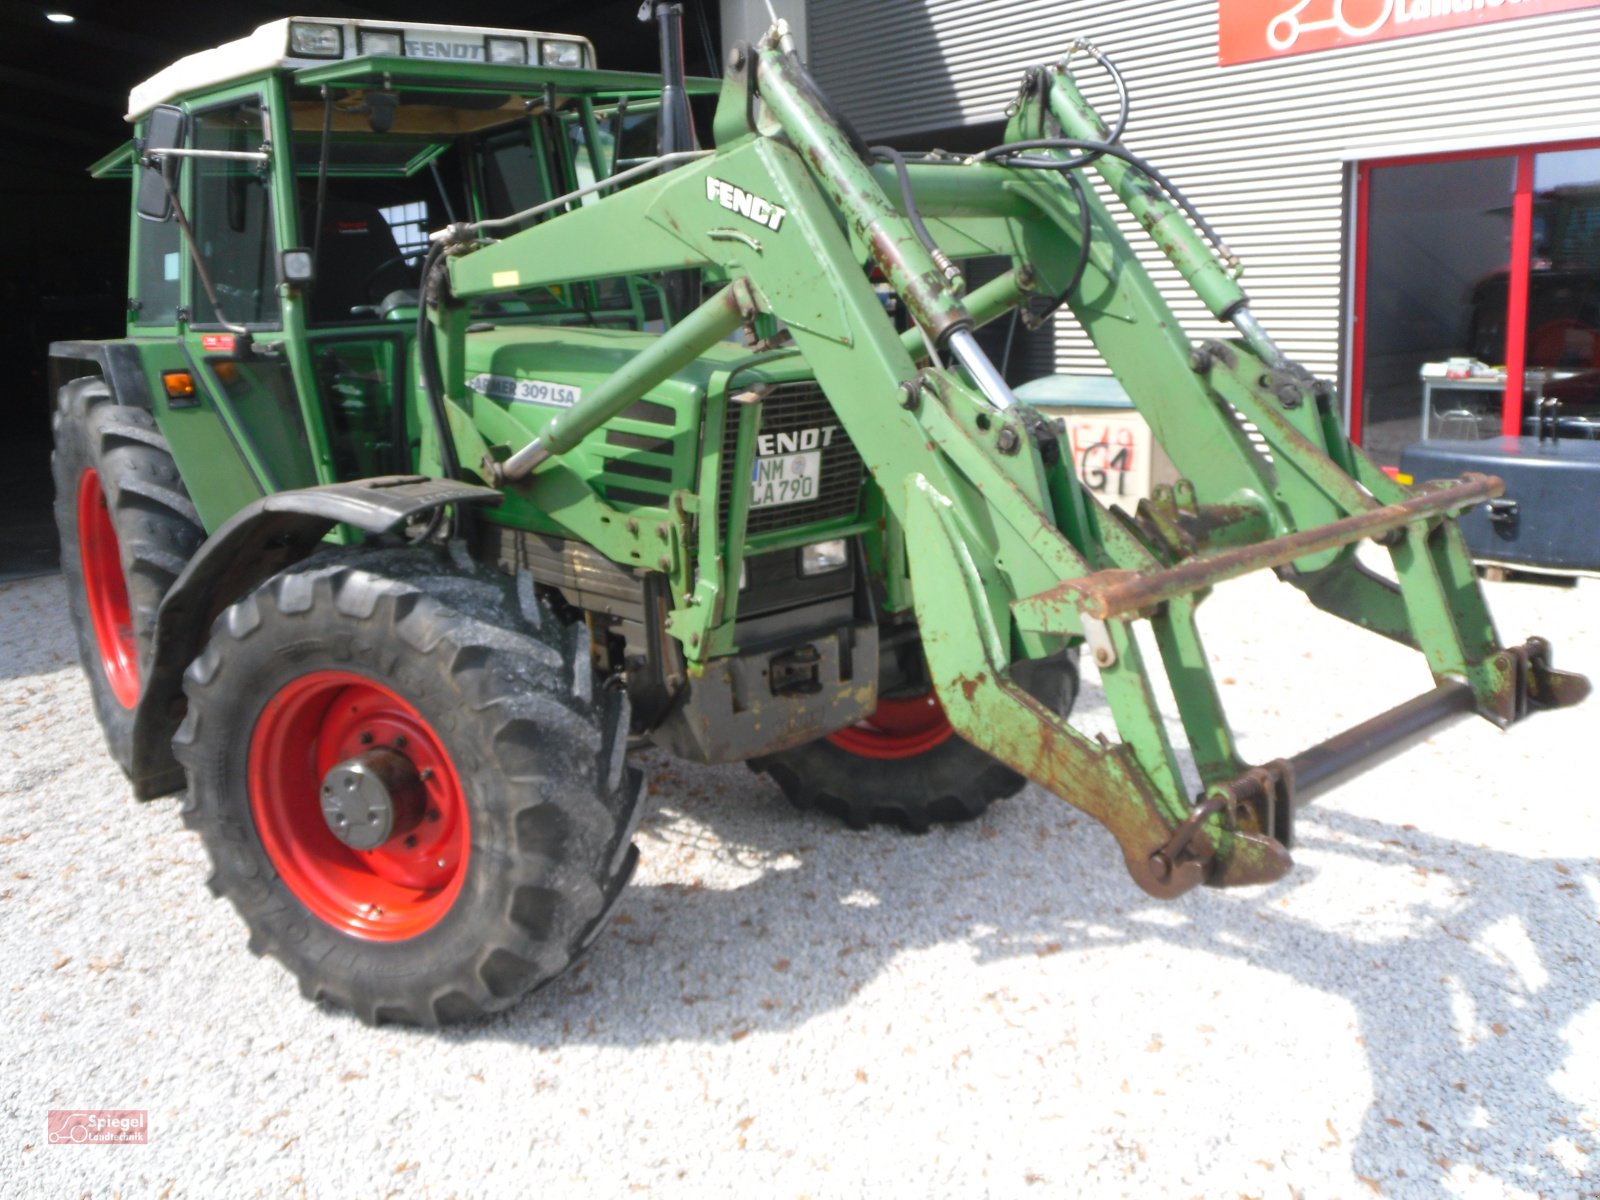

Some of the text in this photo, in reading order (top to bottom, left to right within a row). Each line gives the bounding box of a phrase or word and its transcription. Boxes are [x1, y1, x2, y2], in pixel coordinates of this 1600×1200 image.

[405, 41, 485, 59] FENDT
[705, 175, 787, 233] FENDT
[468, 376, 576, 404] ARMER 309 LSA
[757, 425, 838, 456] ENDT
[759, 459, 785, 482] NM
